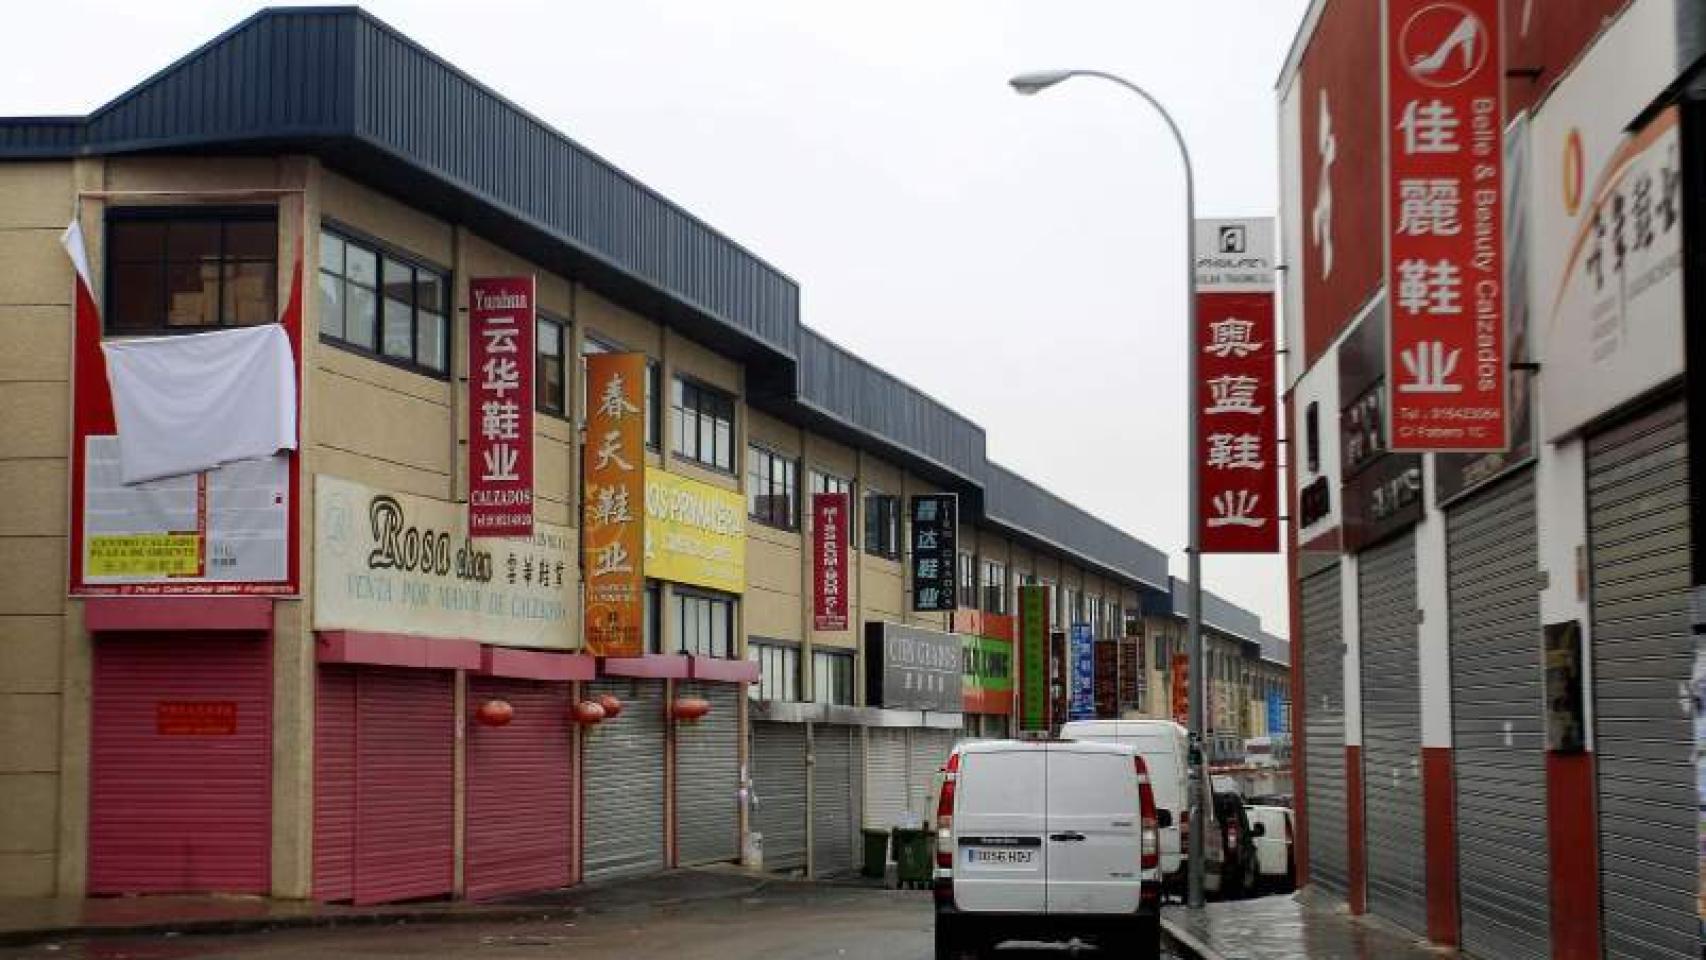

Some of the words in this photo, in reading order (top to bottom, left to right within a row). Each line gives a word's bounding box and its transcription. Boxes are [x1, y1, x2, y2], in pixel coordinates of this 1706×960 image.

[1396, 99, 1462, 393] 佳麗鞋业
[1473, 190, 1497, 272] Beauty
[482, 316, 520, 481] 云华鞋业
[1477, 279, 1498, 392] Calzados
[368, 494, 451, 577] Rosa
[593, 371, 642, 577] 春天鞋业
